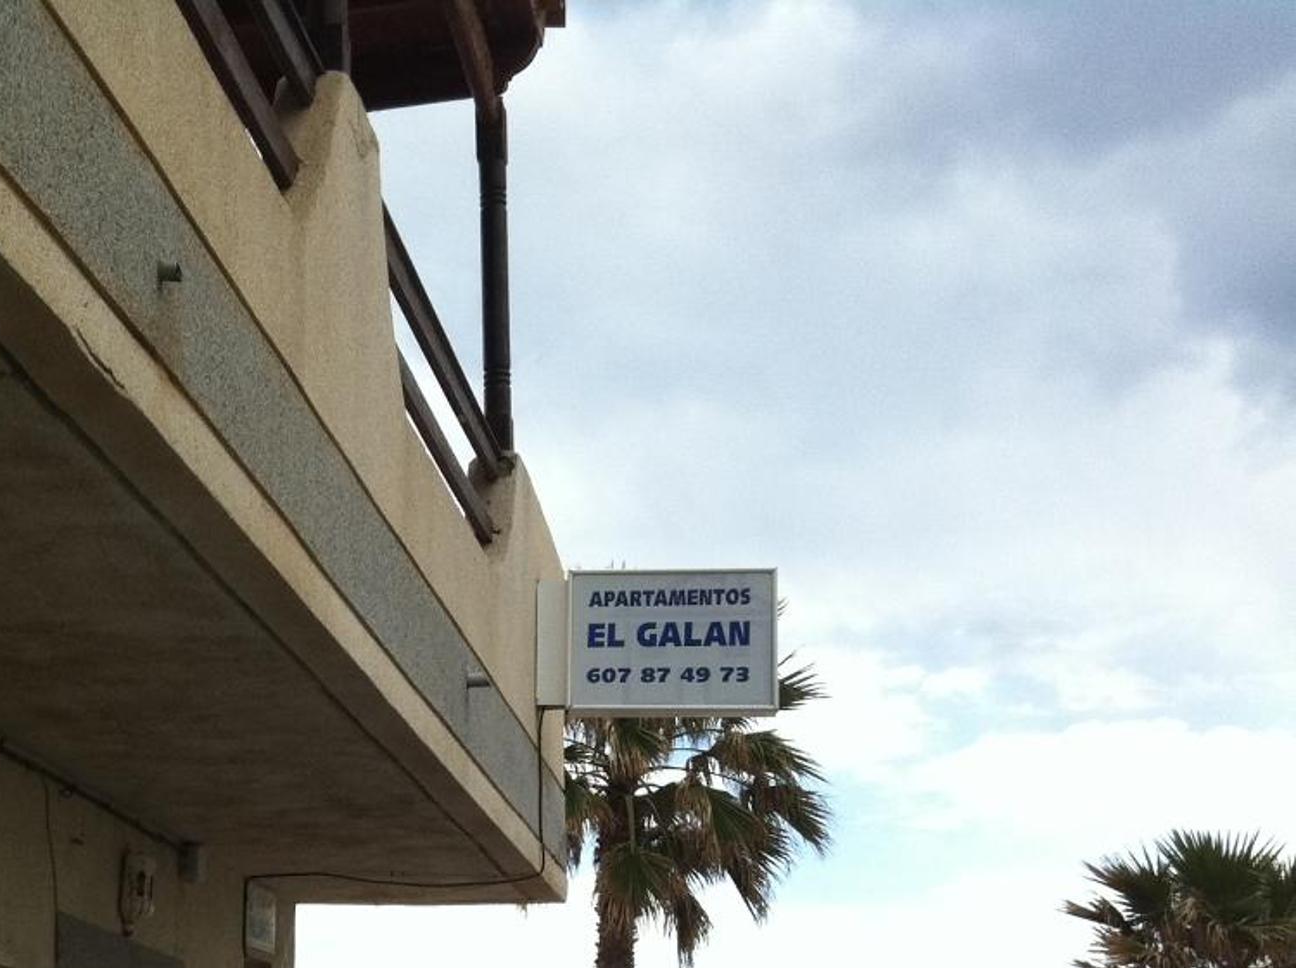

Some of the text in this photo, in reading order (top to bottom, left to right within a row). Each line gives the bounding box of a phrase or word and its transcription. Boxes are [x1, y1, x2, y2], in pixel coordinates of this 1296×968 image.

[588, 588, 751, 607] APARTAMENTOS
[587, 621, 751, 648] EL GALAN
[586, 666, 750, 684] 607 87 49 73
